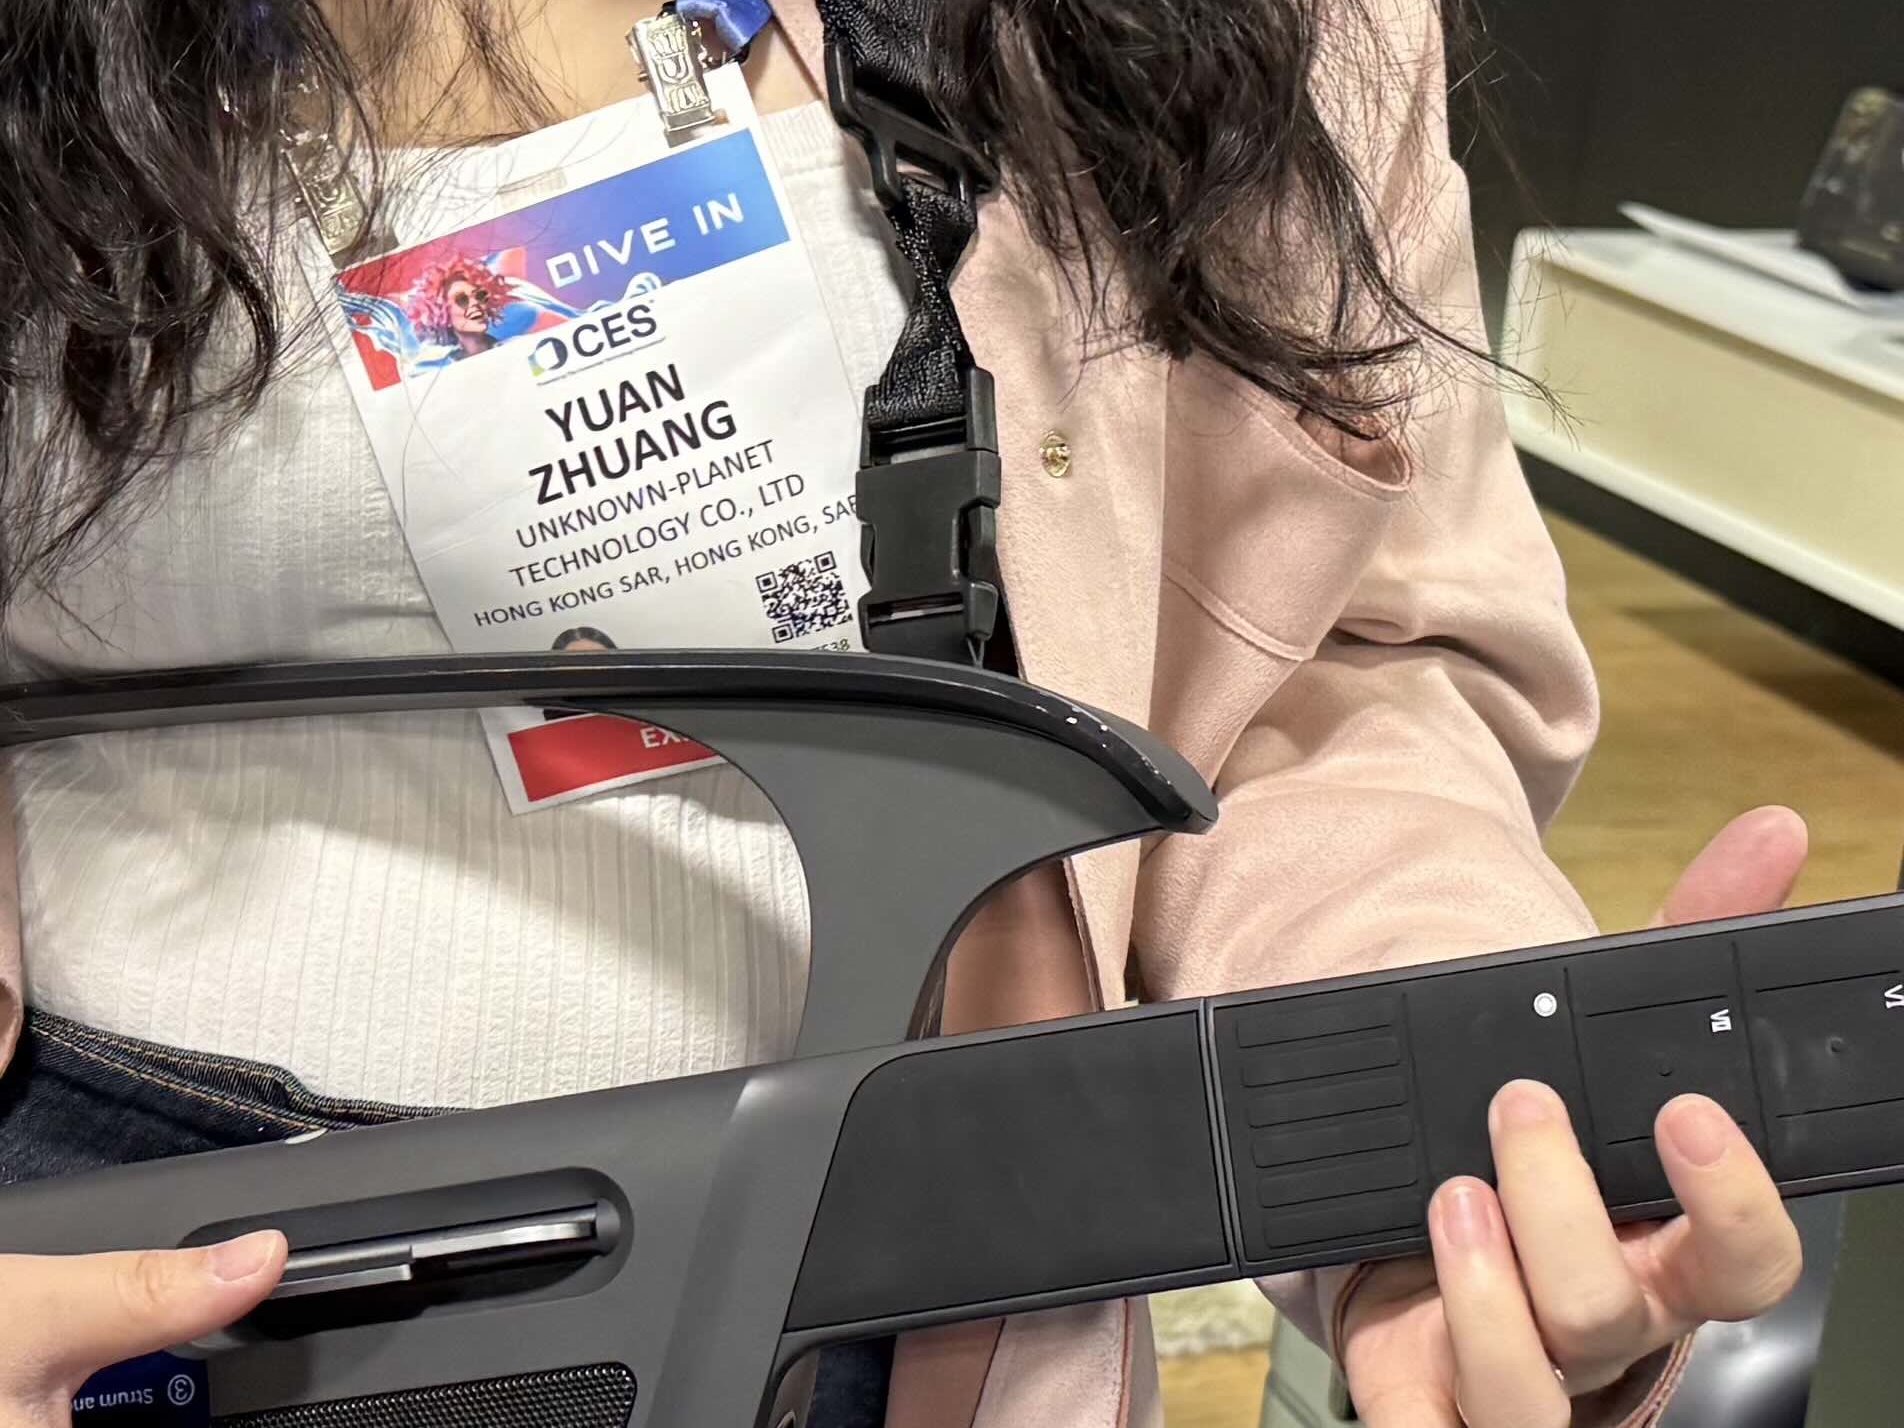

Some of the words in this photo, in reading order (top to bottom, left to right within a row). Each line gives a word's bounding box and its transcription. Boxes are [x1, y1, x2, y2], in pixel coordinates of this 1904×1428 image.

[546, 217, 676, 289] DIVE
[692, 192, 744, 236] IN
[572, 304, 657, 357] CES
[528, 400, 737, 505] ZHUANG
[545, 363, 685, 443] YUAN
[509, 512, 691, 587] TECHNOLOGY
[700, 498, 753, 528] CO.,
[759, 474, 805, 507] LTD
[516, 439, 774, 549] UNKNOWN-PLANET
[474, 600, 543, 628] HONG
[549, 581, 614, 612] KONG
[621, 566, 671, 593] SAR,
[675, 540, 742, 577] HONG
[747, 515, 818, 552] KONG,
[99, 1388, 154, 1407] Strum
